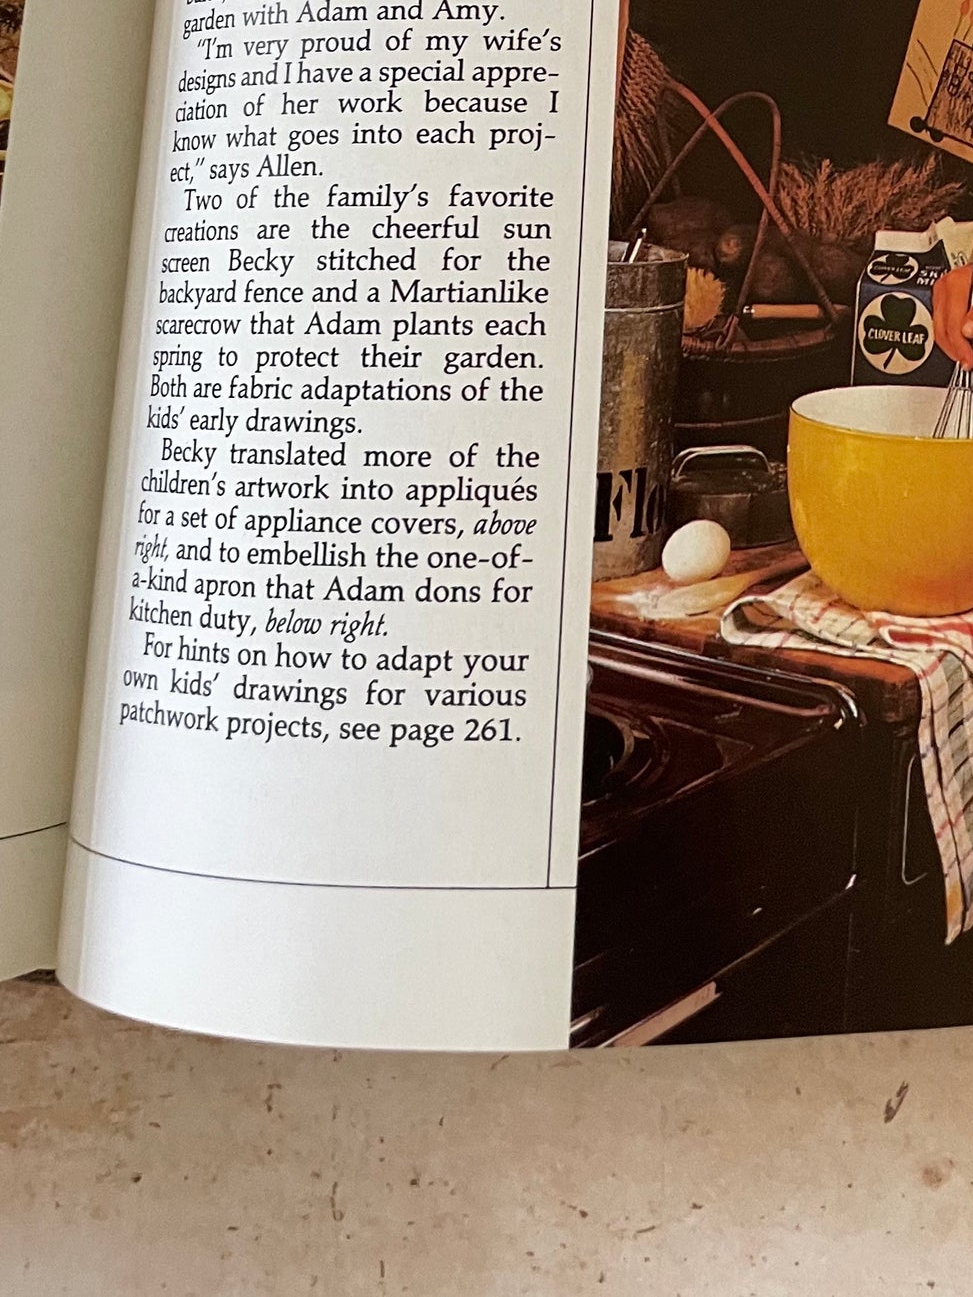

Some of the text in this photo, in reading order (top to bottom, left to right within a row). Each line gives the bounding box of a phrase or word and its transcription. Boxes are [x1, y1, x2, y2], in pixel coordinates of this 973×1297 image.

[183, 8, 235, 40] garden
[242, 2, 288, 26] with
[296, 0, 368, 23] Adam
[244, 39, 289, 60] very
[299, 28, 371, 59] proud
[385, 27, 413, 51] of
[425, 35, 469, 57] my
[483, 28, 561, 51] wife's
[176, 89, 559, 122] ciation of her work because I
[184, 183, 553, 213] Two of the family's favorite
[161, 246, 550, 277] screen Becky stitched for the
[159, 279, 549, 310] backyard fence and a Martianlike
[867, 328, 926, 345] CLOVER LEAF
[153, 343, 543, 375] spring to protect their garden.
[147, 405, 362, 440] kids' early drawings.
[161, 438, 540, 469] Becky translated more of the
[141, 468, 537, 508] children's artwork into appliqués
[138, 499, 537, 539] for a set of appliance covers, above
[135, 533, 533, 569] right, and to embellish the one-of-
[132, 565, 533, 603] a-kind apron that Adam dons for
[129, 596, 387, 643] kitchen duty, below right.
[143, 632, 529, 679] For hints on how to adapt your
[123, 668, 526, 711] own kids' drawings for various
[119, 700, 520, 748] patchwork projects, see page 261.
